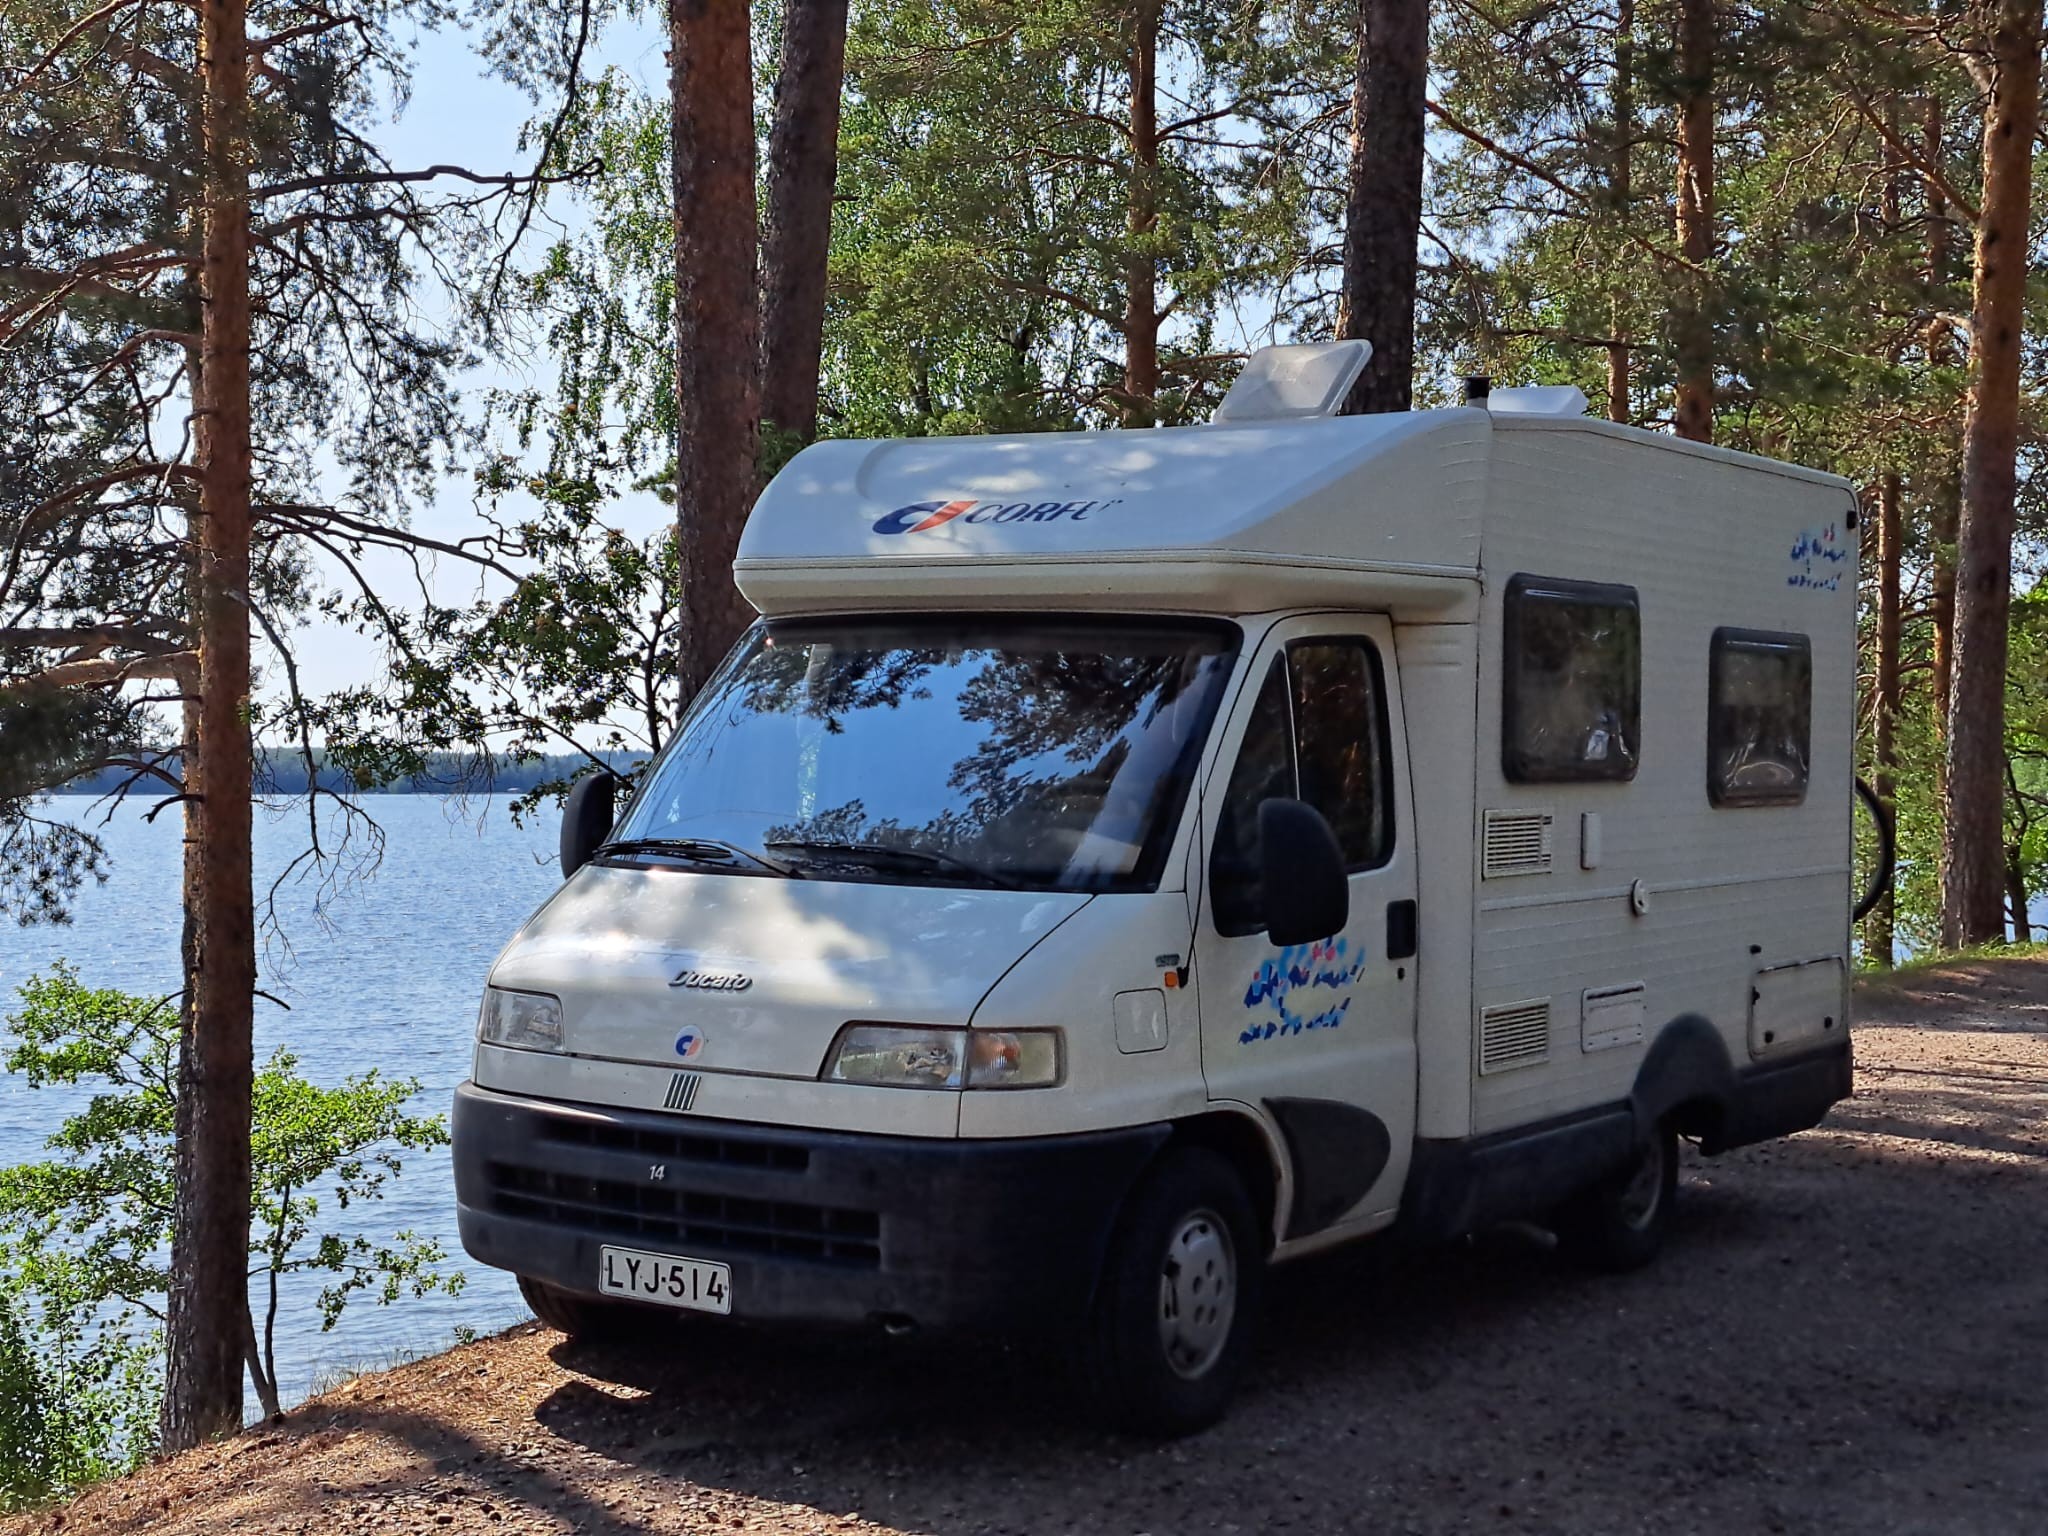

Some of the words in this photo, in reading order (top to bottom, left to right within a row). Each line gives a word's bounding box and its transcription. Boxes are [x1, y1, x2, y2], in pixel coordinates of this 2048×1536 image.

[668, 971, 753, 991] Ducato
[650, 1164, 665, 1180] 14
[607, 1255, 724, 1304] LYJ-514
